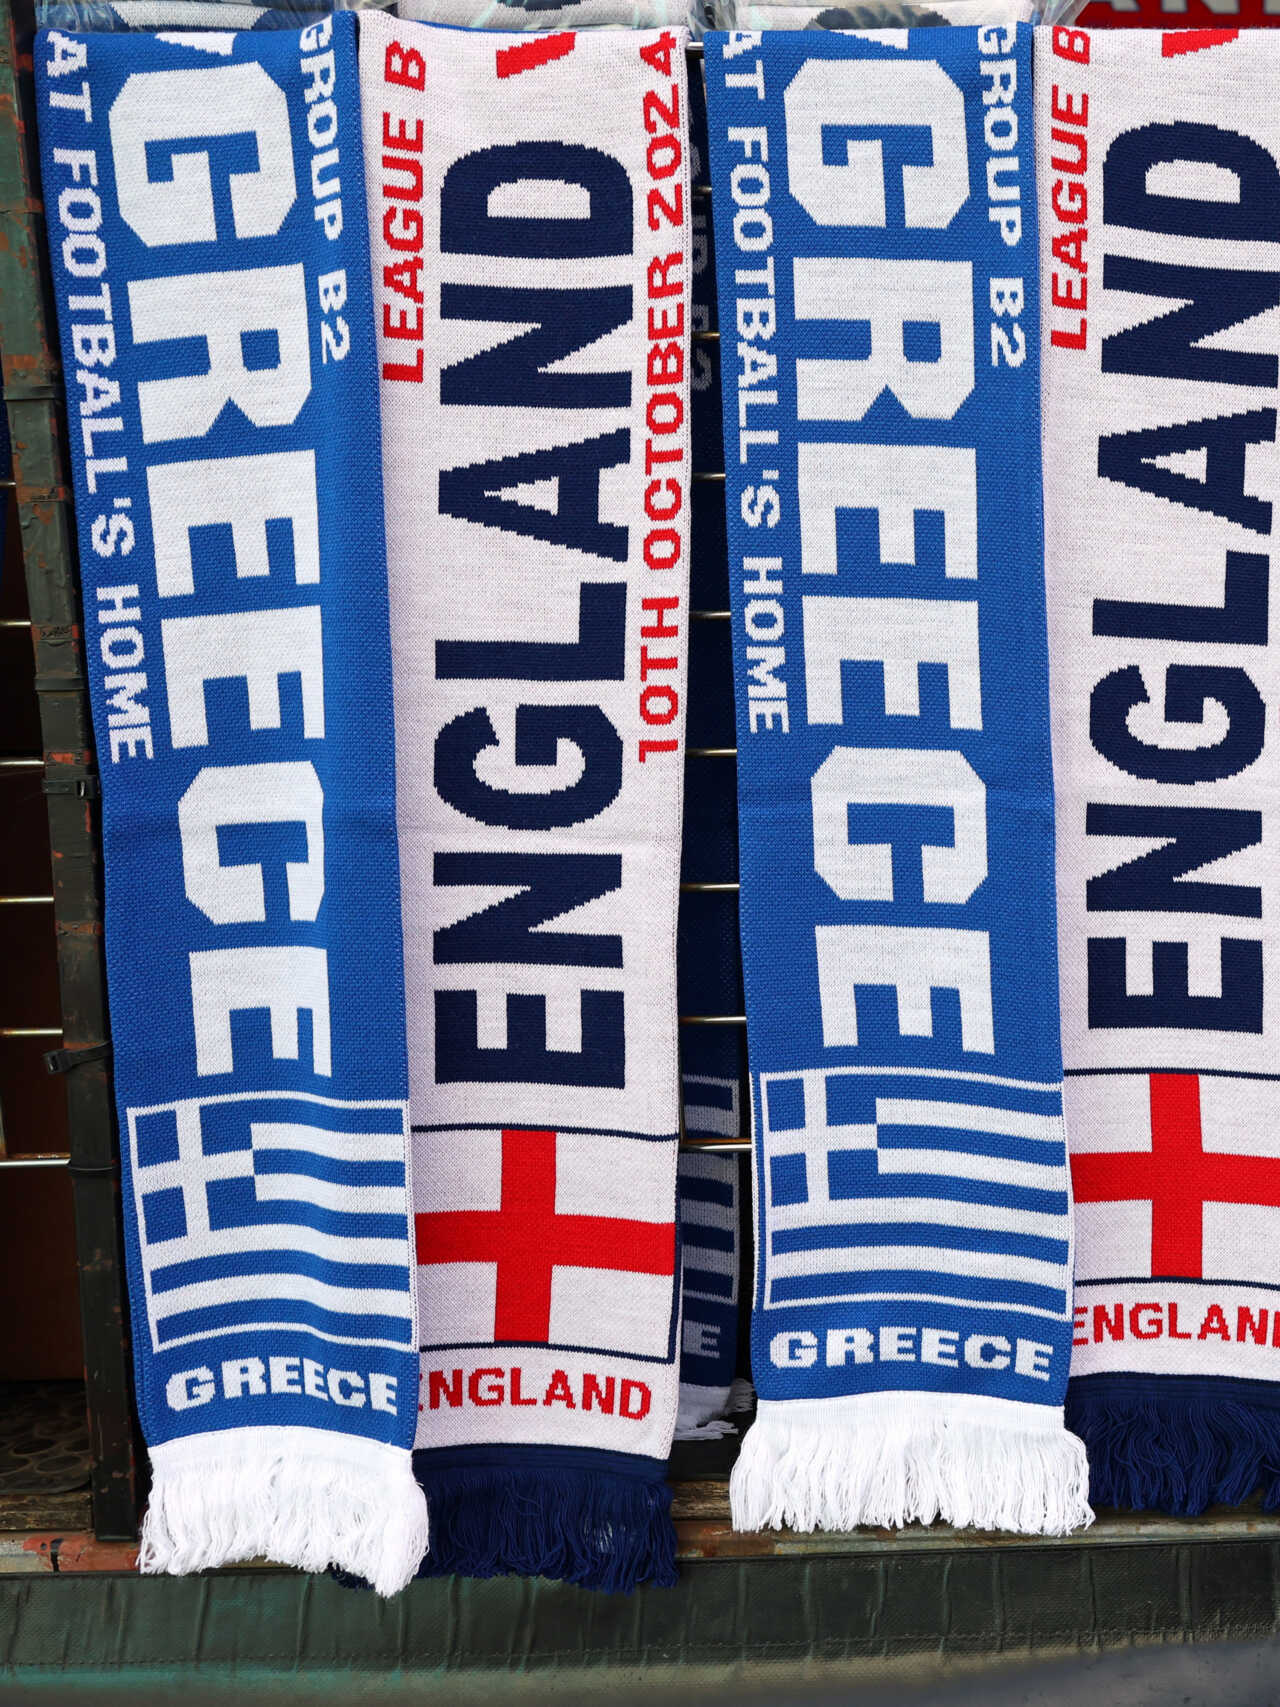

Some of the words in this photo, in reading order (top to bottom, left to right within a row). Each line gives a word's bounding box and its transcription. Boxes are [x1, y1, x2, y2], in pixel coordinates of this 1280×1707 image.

[48, 32, 93, 123] AT
[301, 16, 344, 241] GROUP
[386, 43, 426, 92] B
[641, 33, 684, 231] 2024
[724, 31, 766, 100] AT
[977, 22, 1023, 247] GROUP
[1054, 27, 1091, 65] B
[383, 114, 424, 383] LEAGUE
[1052, 87, 1089, 350] LEAGUE
[54, 149, 136, 558] FOOTBALL'S
[319, 271, 351, 365] B2
[729, 128, 781, 529] FOOTBALL'S
[991, 279, 1027, 368] B2
[645, 254, 685, 570] OCTOBER
[108, 62, 333, 1077] GREECE
[434, 143, 634, 1090] ENGLAND
[744, 558, 790, 734] HOME
[785, 59, 995, 1055] GREECE
[98, 585, 154, 764] HOME
[640, 598, 680, 763] 10TH
[167, 1358, 398, 1416] GREECE
[419, 1367, 652, 1421] NGLAND
[771, 1328, 1054, 1382] GREECE
